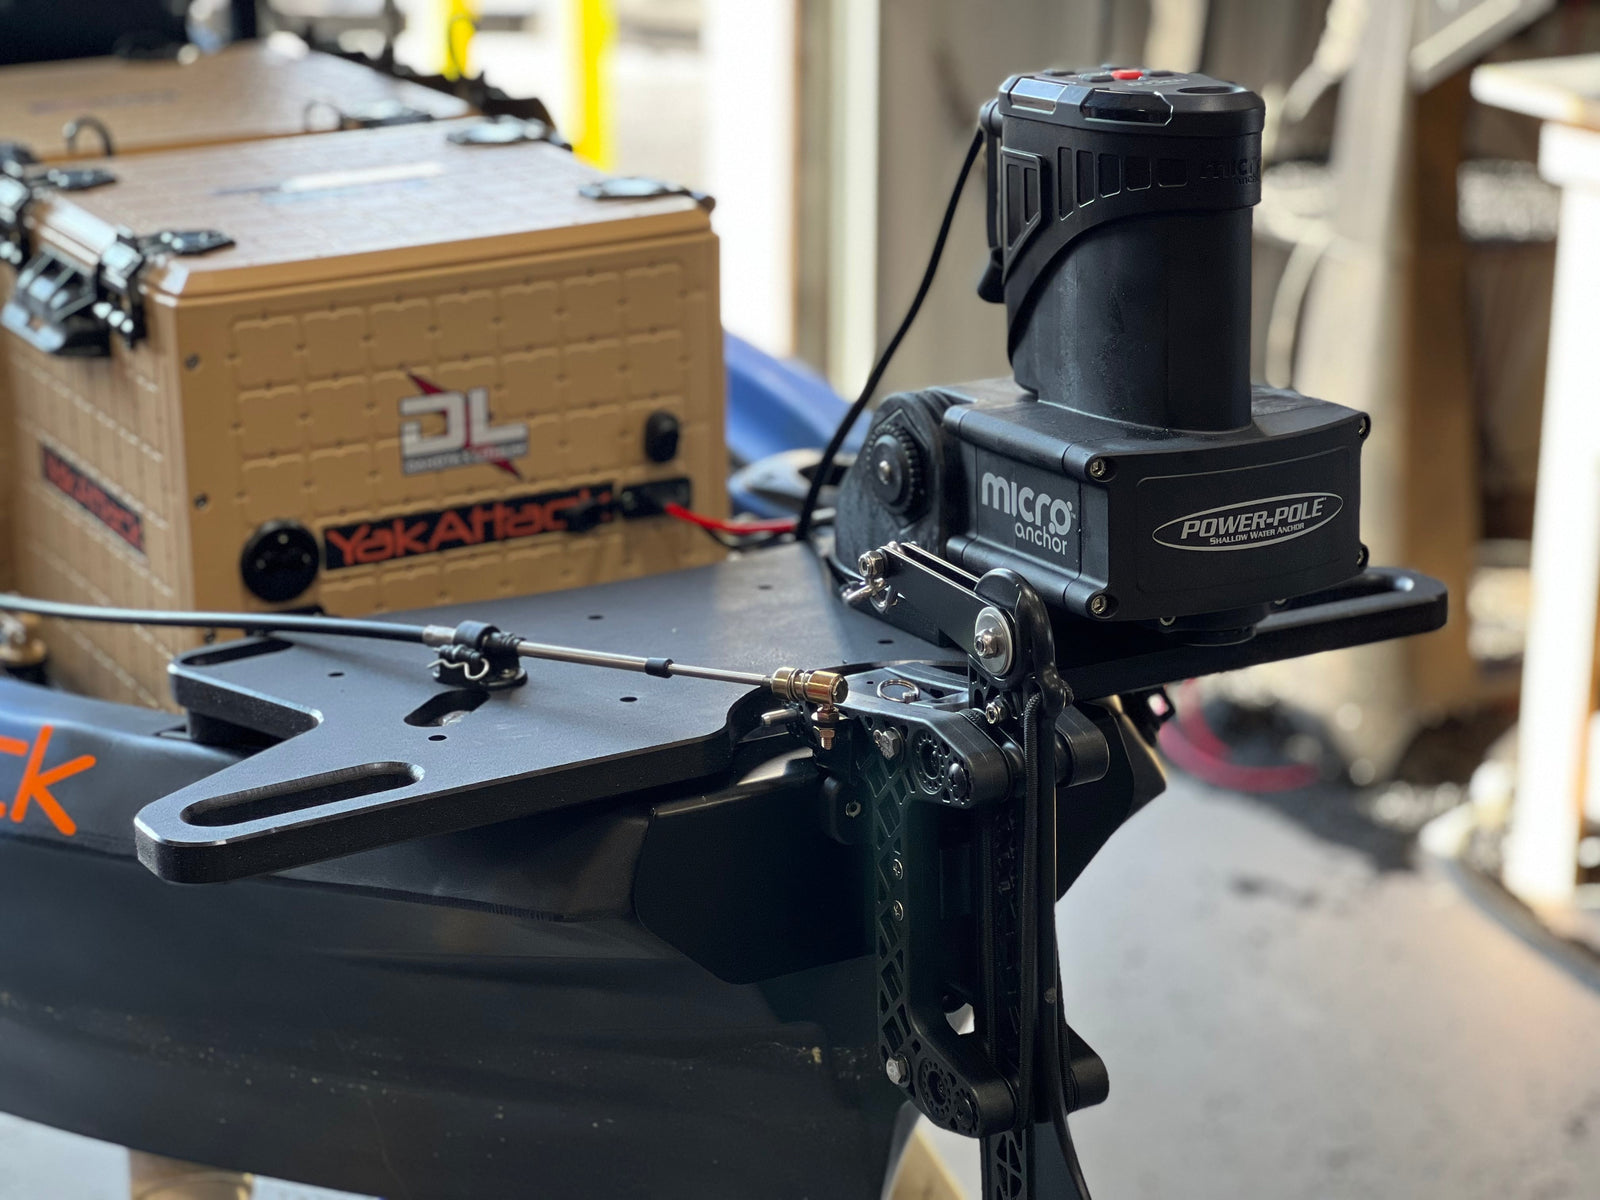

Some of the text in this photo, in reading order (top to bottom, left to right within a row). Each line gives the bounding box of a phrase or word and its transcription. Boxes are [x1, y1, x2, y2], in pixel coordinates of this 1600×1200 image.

[400, 388, 528, 458] DL
[326, 487, 613, 567] YakAttac
[981, 472, 1073, 536] micro
[1181, 497, 1325, 539] POWER-POLE
[1014, 522, 1067, 556] anchor
[1209, 522, 1305, 545] SHALLOW WATER ANCHOR
